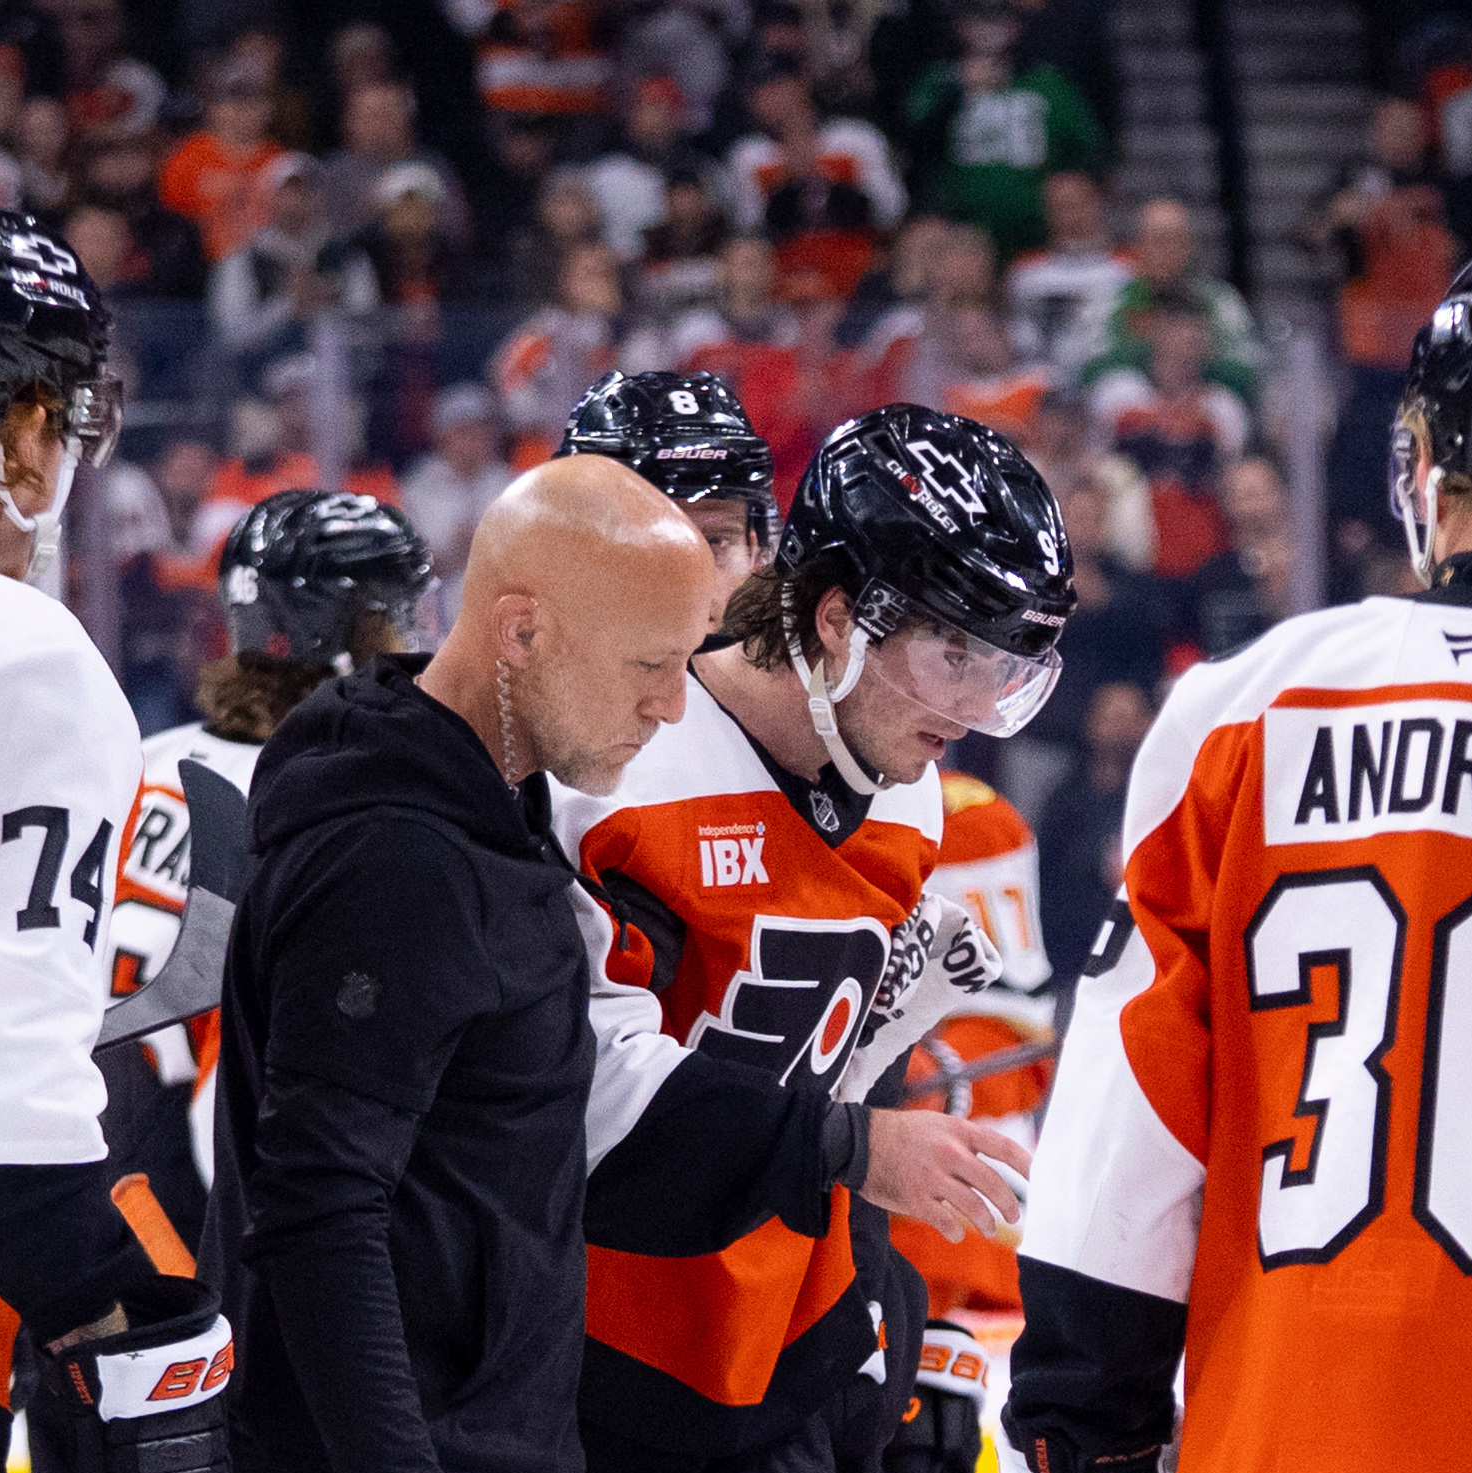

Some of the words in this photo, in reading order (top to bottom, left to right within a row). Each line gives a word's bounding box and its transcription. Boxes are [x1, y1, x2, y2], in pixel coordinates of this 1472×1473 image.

[668, 390, 699, 415] 8
[656, 448, 727, 461] BAUER
[885, 459, 961, 535] CHEVROLET
[1037, 529, 1059, 576] 9
[1020, 608, 1067, 629] BAUER
[697, 823, 756, 838] Independence
[0, 803, 115, 956] 74
[698, 837, 771, 888] IBX
